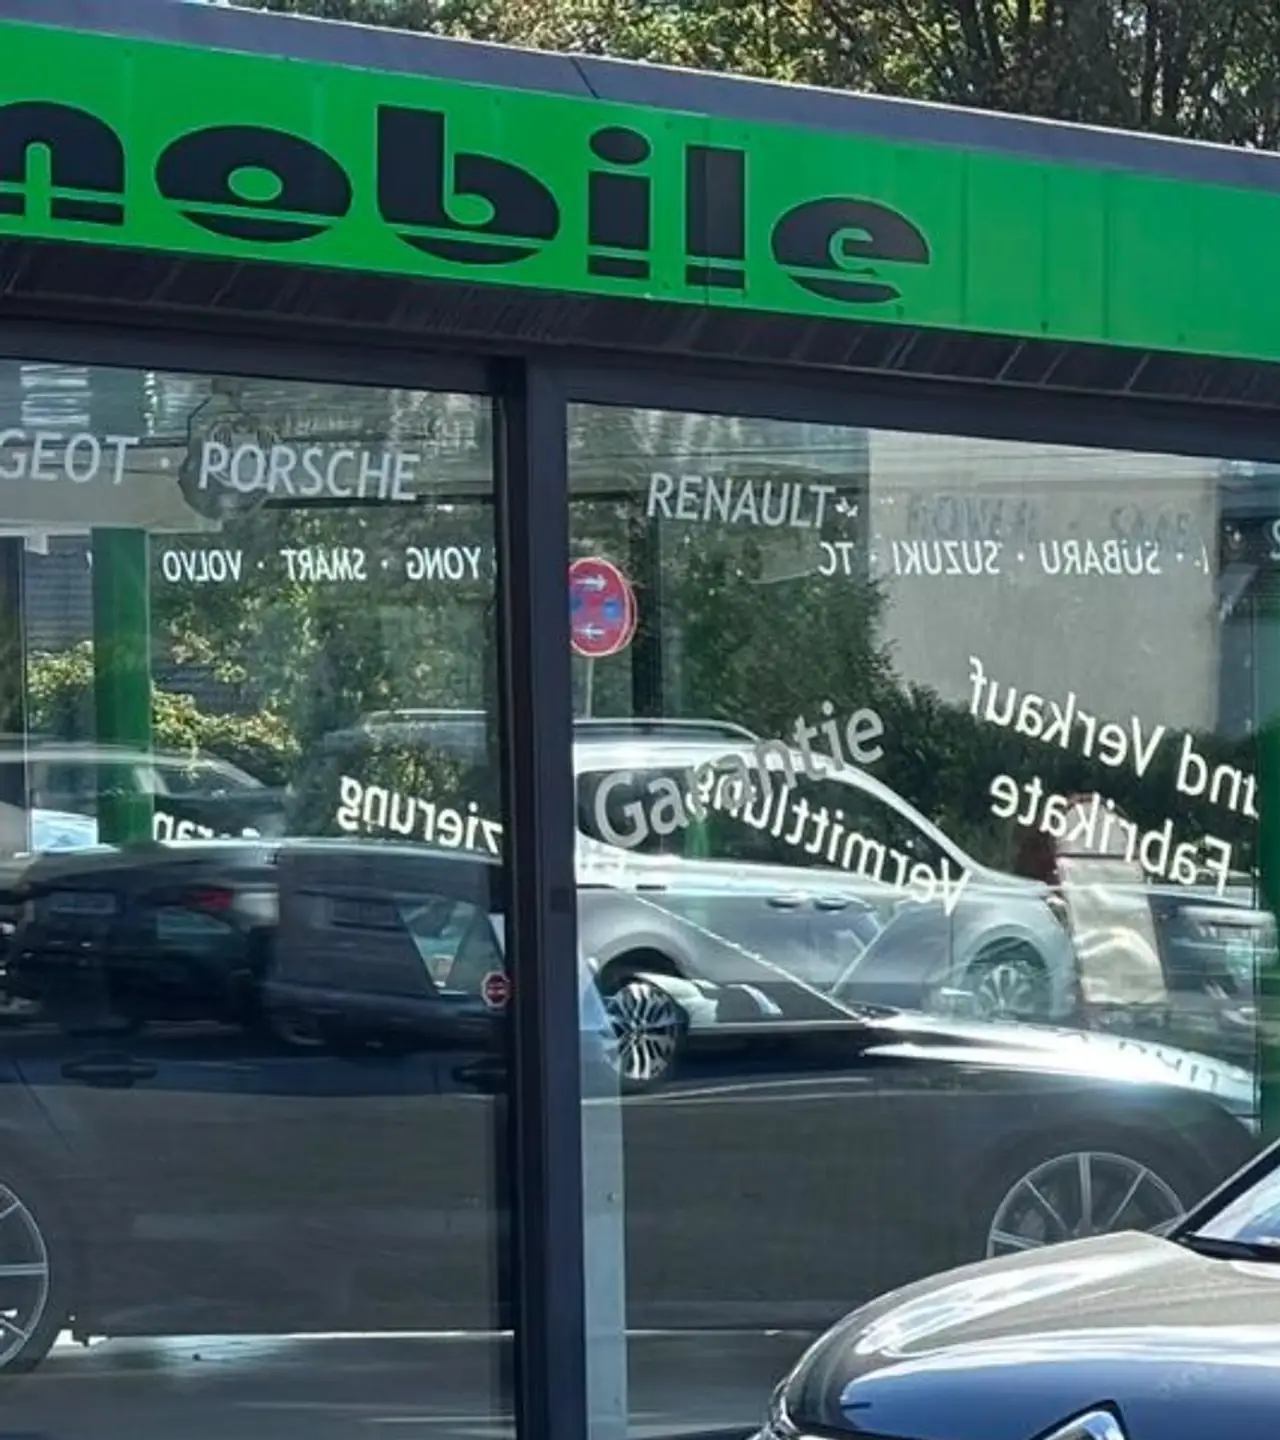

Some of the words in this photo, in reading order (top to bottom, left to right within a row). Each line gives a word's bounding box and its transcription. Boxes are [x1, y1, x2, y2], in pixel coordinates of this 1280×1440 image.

[199, 441, 421, 500] PORSCHE
[647, 472, 836, 529] RENAULT
[595, 701, 884, 848] Garantie
